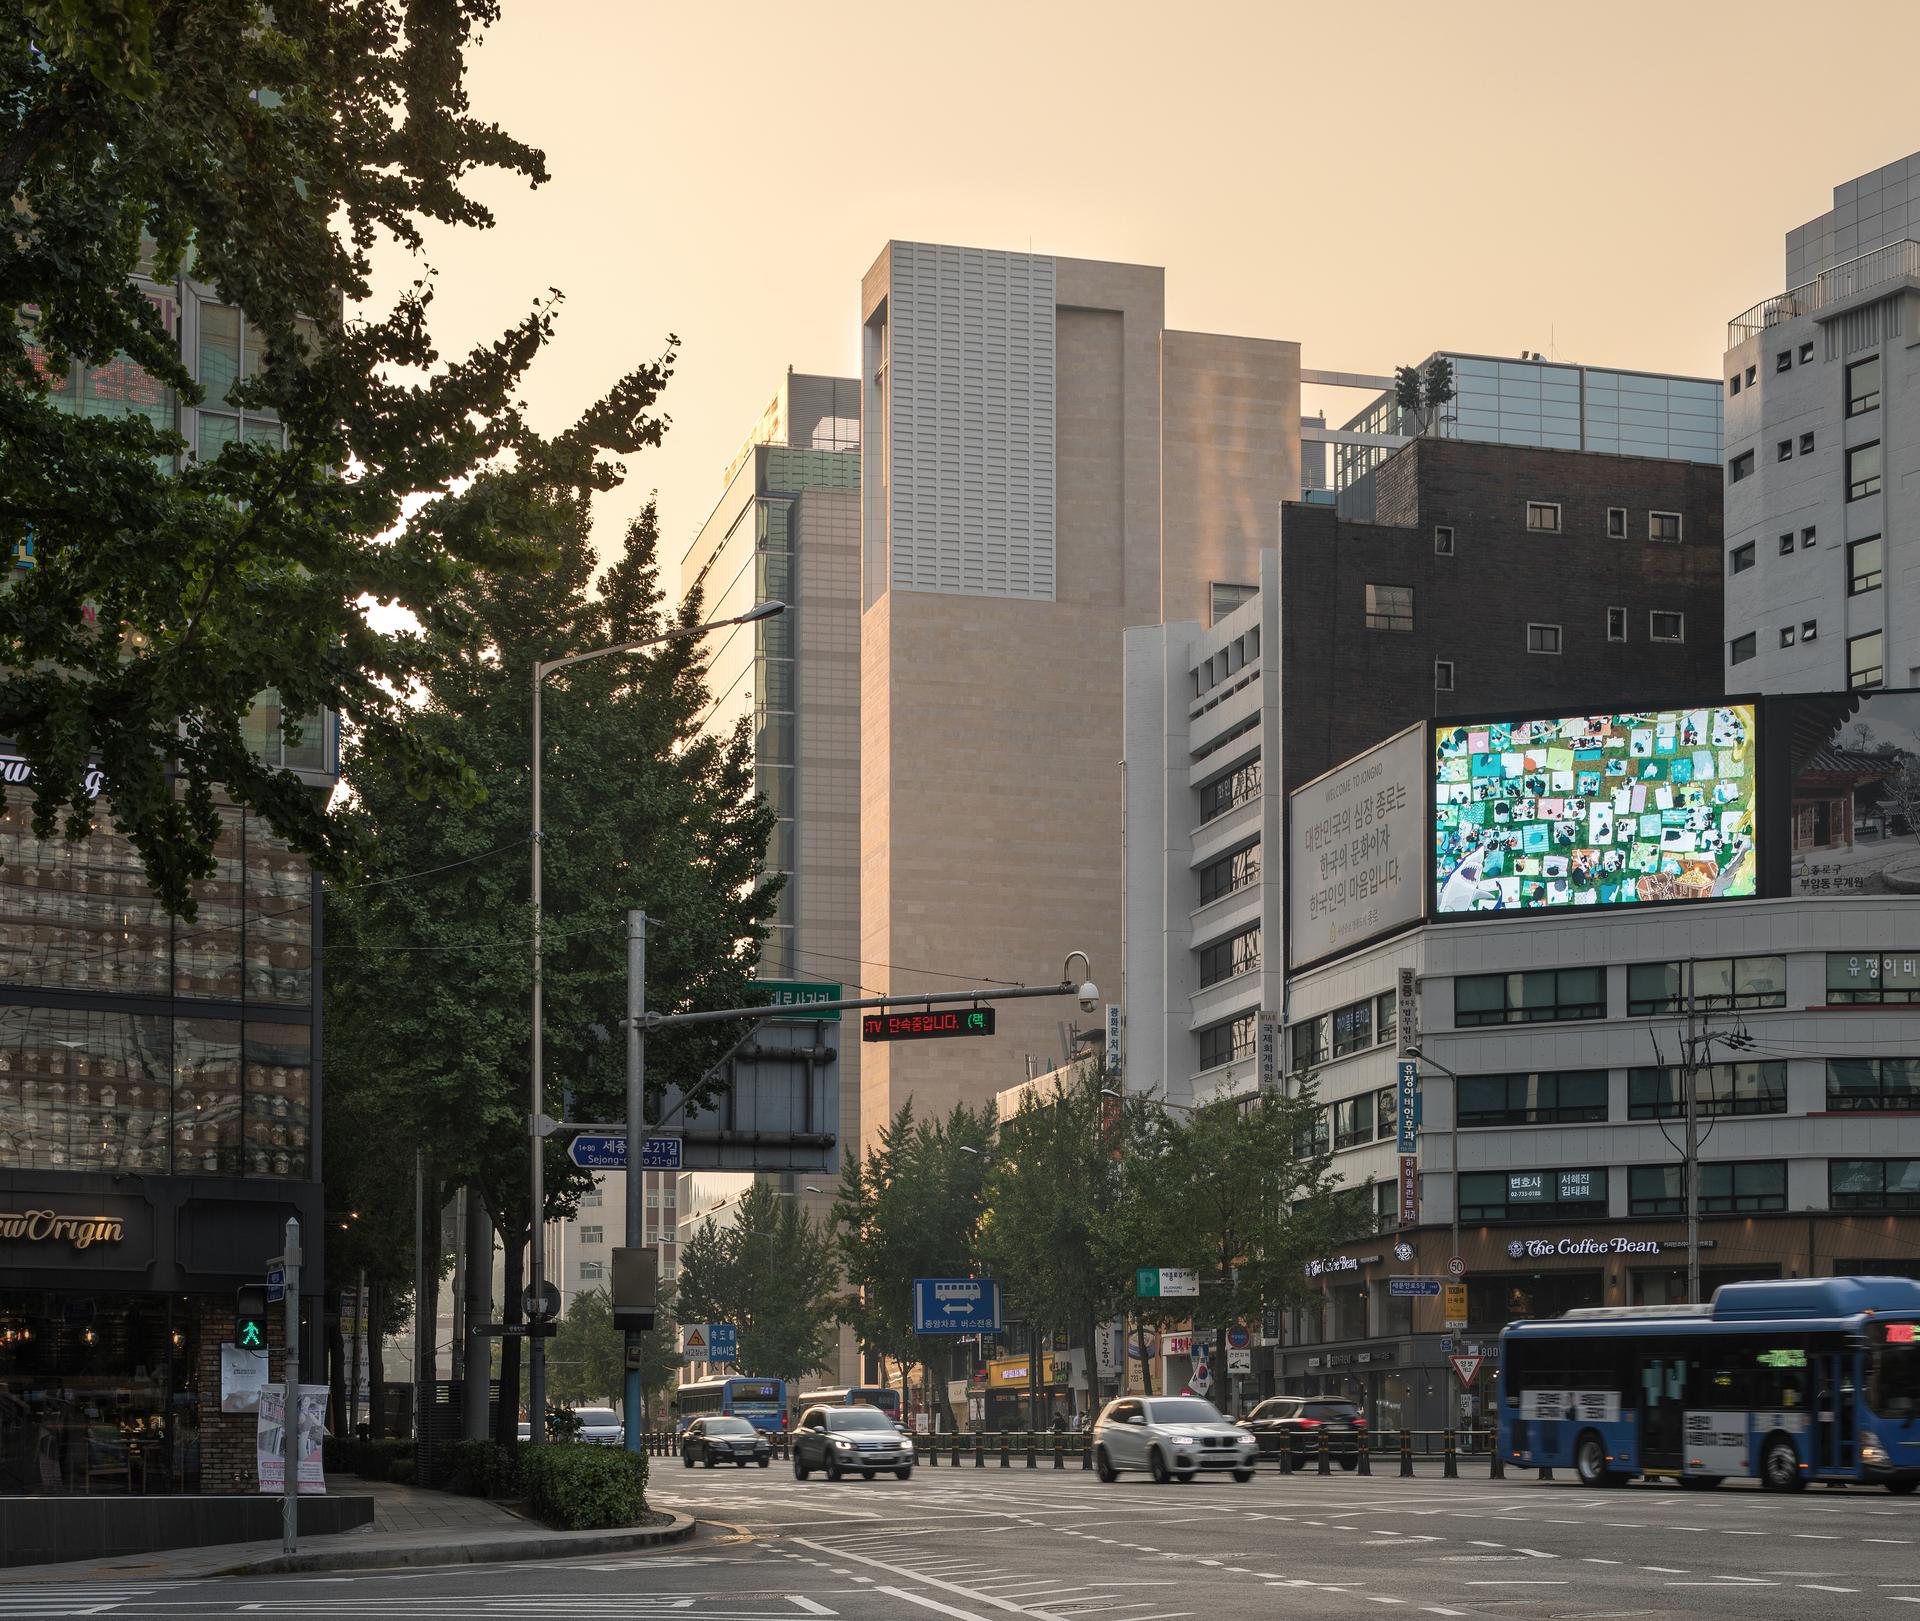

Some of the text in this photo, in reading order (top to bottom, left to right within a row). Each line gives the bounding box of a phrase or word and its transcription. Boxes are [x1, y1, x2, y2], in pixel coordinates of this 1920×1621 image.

[1325, 762, 1383, 802] WELCOME TO JONGNO
[1305, 782, 1406, 852] 대한민국의 심장 종로는
[1320, 824, 1391, 880] 한국의 문화이자
[1811, 864, 1841, 875] 종로구
[1310, 857, 1402, 920] 한국인의 마음입니다.
[1800, 877, 1863, 889] 부암동 무계원
[1368, 909, 1379, 926] 종로
[865, 1020, 882, 1033] TV
[889, 1014, 960, 1033] 단속중입니다.
[1403, 1008, 1412, 1043] 법무법인
[1404, 1065, 1414, 1140] 유정이비인후과
[602, 1140, 677, 1155] 세종로21길
[652, 1157, 677, 1166] 21-gil
[1511, 1176, 1541, 1188] 변호사
[1562, 1173, 1589, 1184] 서혜진
[1562, 1186, 1589, 1196] 김태희
[1525, 1237, 1660, 1257] The Coffee Bean
[1340, 1255, 1357, 1270] Bean
[1451, 1262, 1463, 1272] 50
[1139, 1271, 1155, 1294] P
[925, 1319, 993, 1328] 중앙차로 버스전용
[760, 1386, 773, 1395] 741
